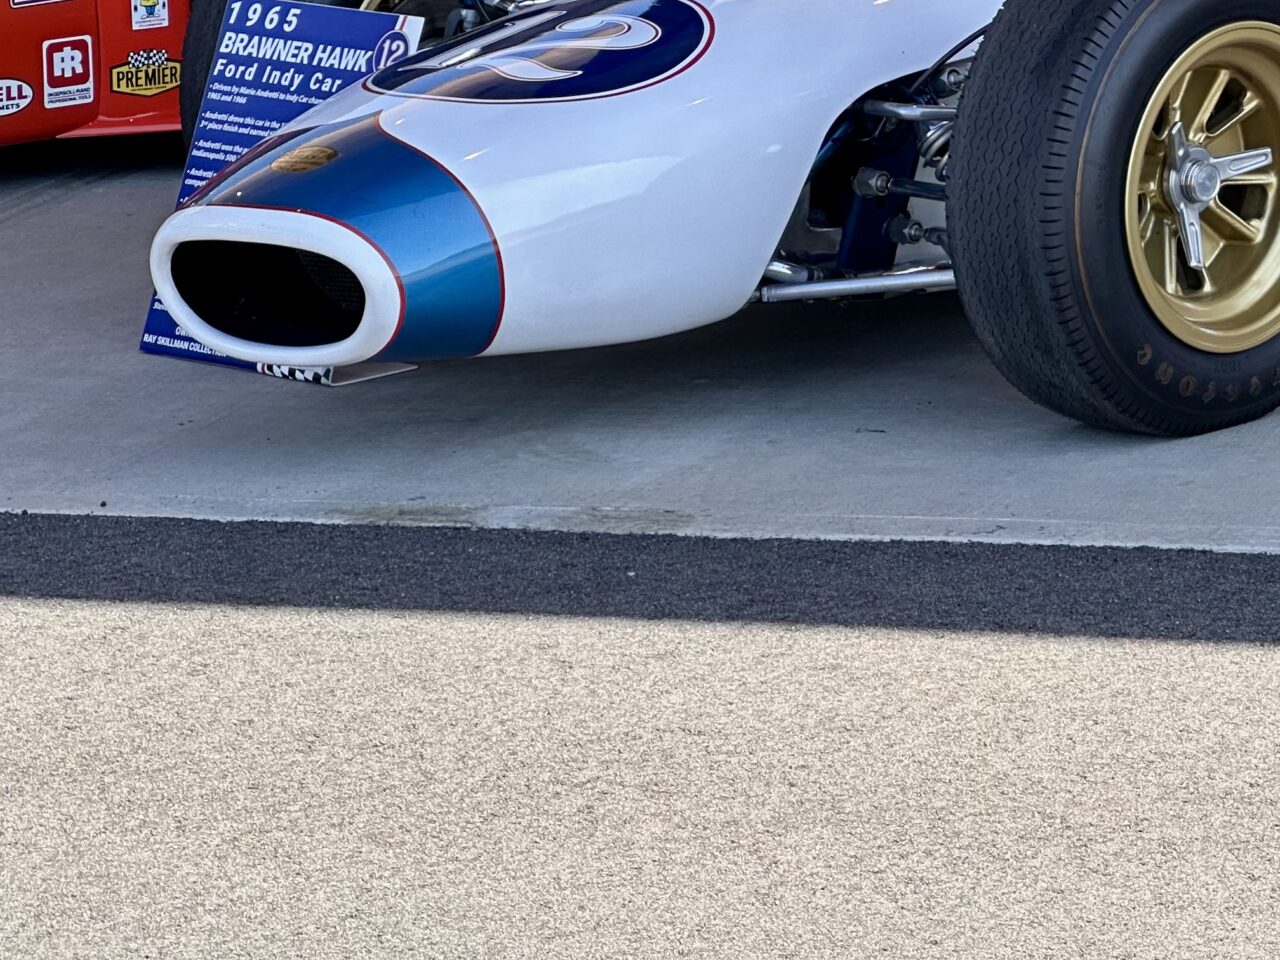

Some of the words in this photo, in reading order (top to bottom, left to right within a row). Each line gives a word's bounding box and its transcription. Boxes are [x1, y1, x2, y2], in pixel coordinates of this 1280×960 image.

[228, 1, 302, 33] 1965
[219, 32, 314, 66] BRAWNER
[312, 45, 373, 72] HAWK
[377, 37, 406, 70] 12
[397, 10, 662, 82] 12
[116, 66, 178, 89] PREMIER
[213, 59, 256, 82] Ford
[262, 66, 304, 92] Indy
[309, 72, 343, 93] Car
[207, 91, 221, 100] 1965
[220, 93, 232, 102] and
[232, 95, 248, 105] 1966
[212, 82, 232, 92] Driven
[231, 85, 239, 94] by
[239, 86, 256, 96] Mario
[255, 88, 278, 99] Andretti
[278, 92, 286, 100] to
[285, 93, 299, 104] Indy
[298, 95, 308, 103] Car
[204, 110, 229, 122] Andretti
[244, 116, 255, 126] this
[255, 119, 264, 128] car
[264, 120, 271, 129] in
[270, 121, 281, 130] the
[207, 122, 223, 132] place
[222, 123, 239, 133] finish
[238, 126, 250, 135] and
[249, 128, 269, 137] earned
[191, 148, 226, 161] Indianapolis
[197, 140, 222, 151] Andretti
[221, 143, 234, 152] won
[232, 144, 243, 153] the
[189, 168, 214, 179] Andretti
[143, 333, 158, 344] RAY
[156, 335, 189, 350] SKILLMAN
